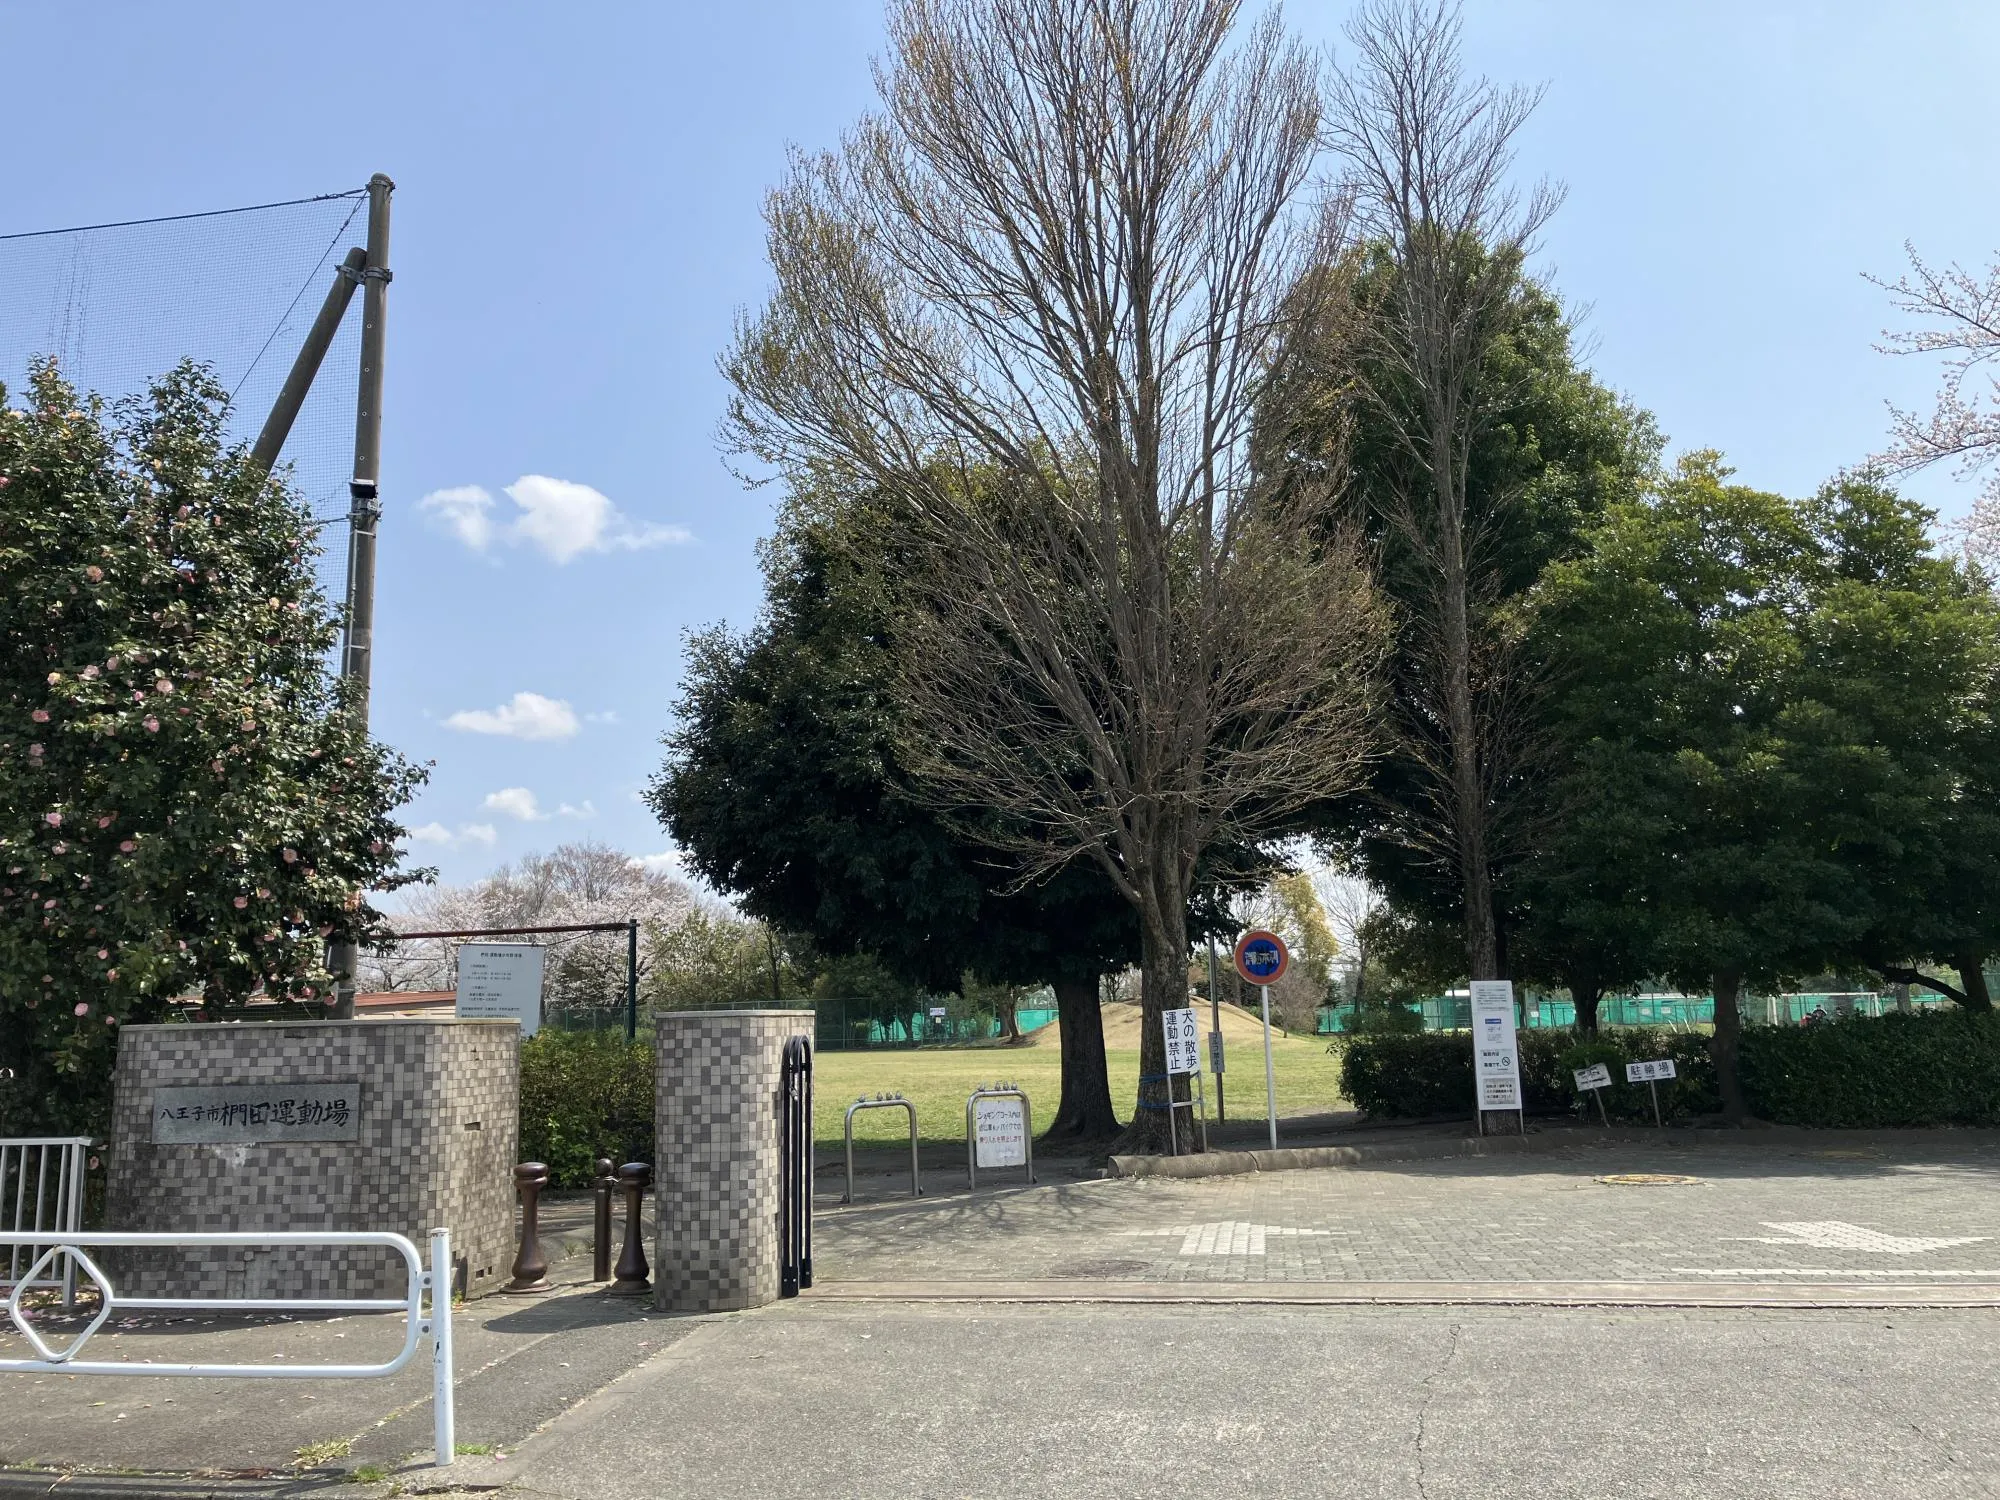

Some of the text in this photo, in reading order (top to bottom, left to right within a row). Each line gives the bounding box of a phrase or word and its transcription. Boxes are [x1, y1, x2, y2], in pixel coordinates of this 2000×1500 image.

[1165, 1011, 1181, 1070] 運動禁止
[1182, 1009, 1197, 1069] 犬の散歩
[1630, 1061, 1669, 1076] 駐輪場
